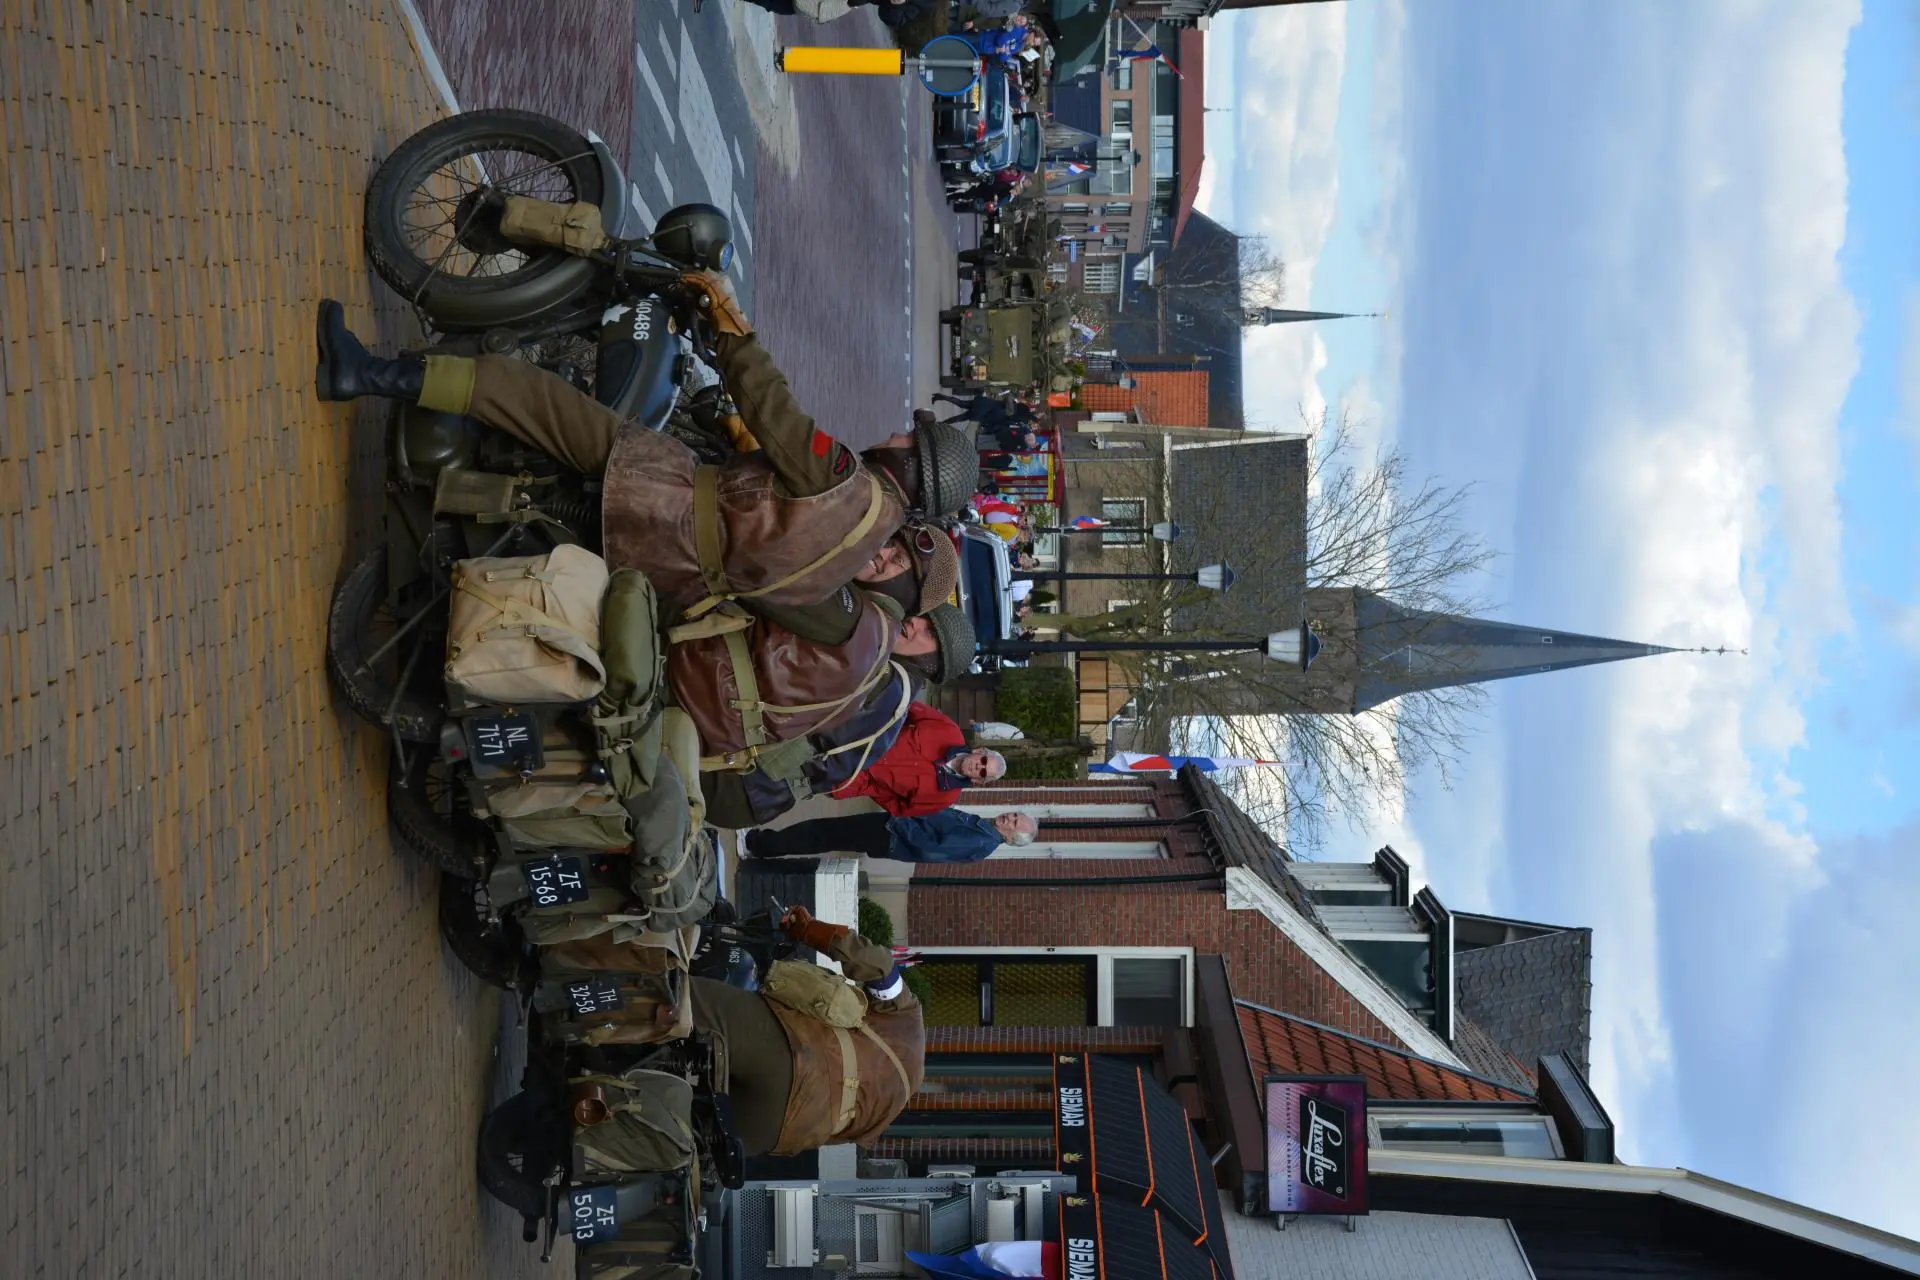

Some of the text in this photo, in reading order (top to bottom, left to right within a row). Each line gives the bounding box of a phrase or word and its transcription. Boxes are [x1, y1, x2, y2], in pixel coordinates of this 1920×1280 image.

[477, 724, 505, 756] 71-71
[505, 727, 529, 748] NL
[558, 871, 582, 889] ZF
[597, 988, 618, 1003] TH
[1060, 1087, 1085, 1127] SIEMAR
[1302, 1100, 1343, 1186] Luxaflex
[574, 1194, 594, 1240] 50-13
[596, 1204, 615, 1226] ZF
